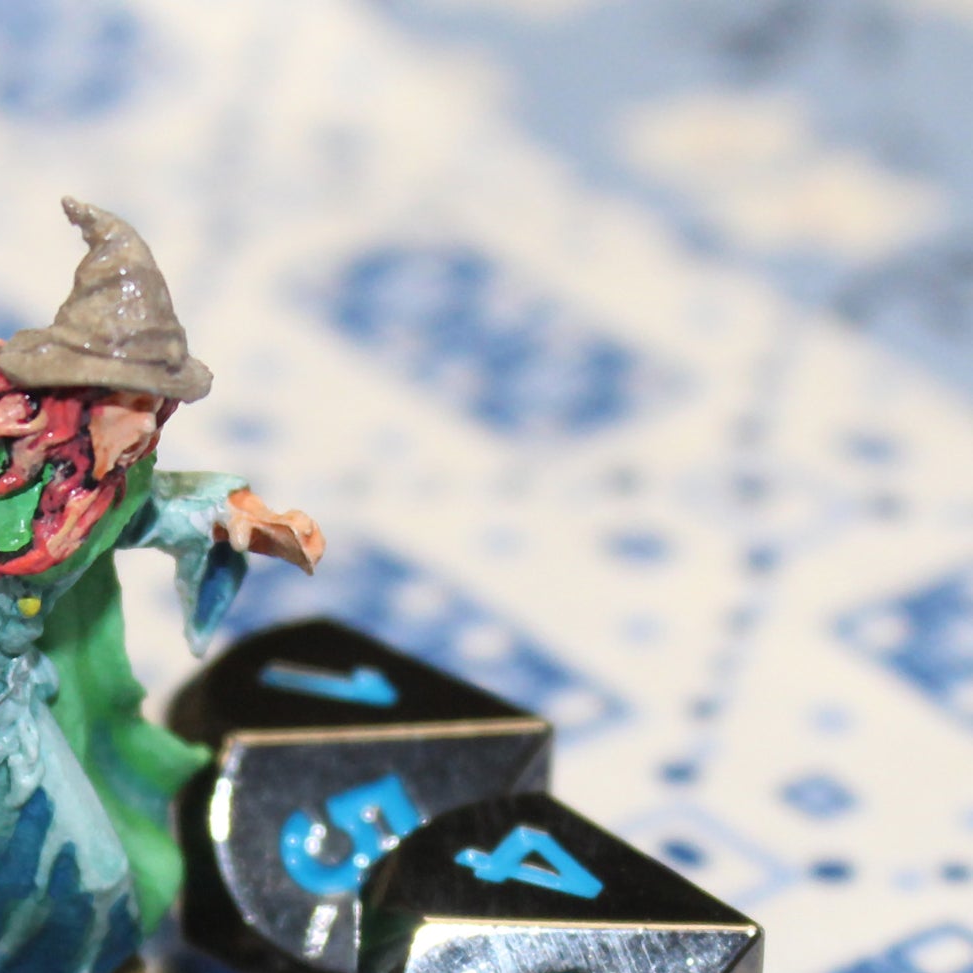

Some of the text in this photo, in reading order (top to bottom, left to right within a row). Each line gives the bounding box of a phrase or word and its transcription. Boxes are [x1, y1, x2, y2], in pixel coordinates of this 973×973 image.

[258, 660, 398, 707] 1
[278, 774, 427, 894] 5
[454, 825, 604, 899] 4
